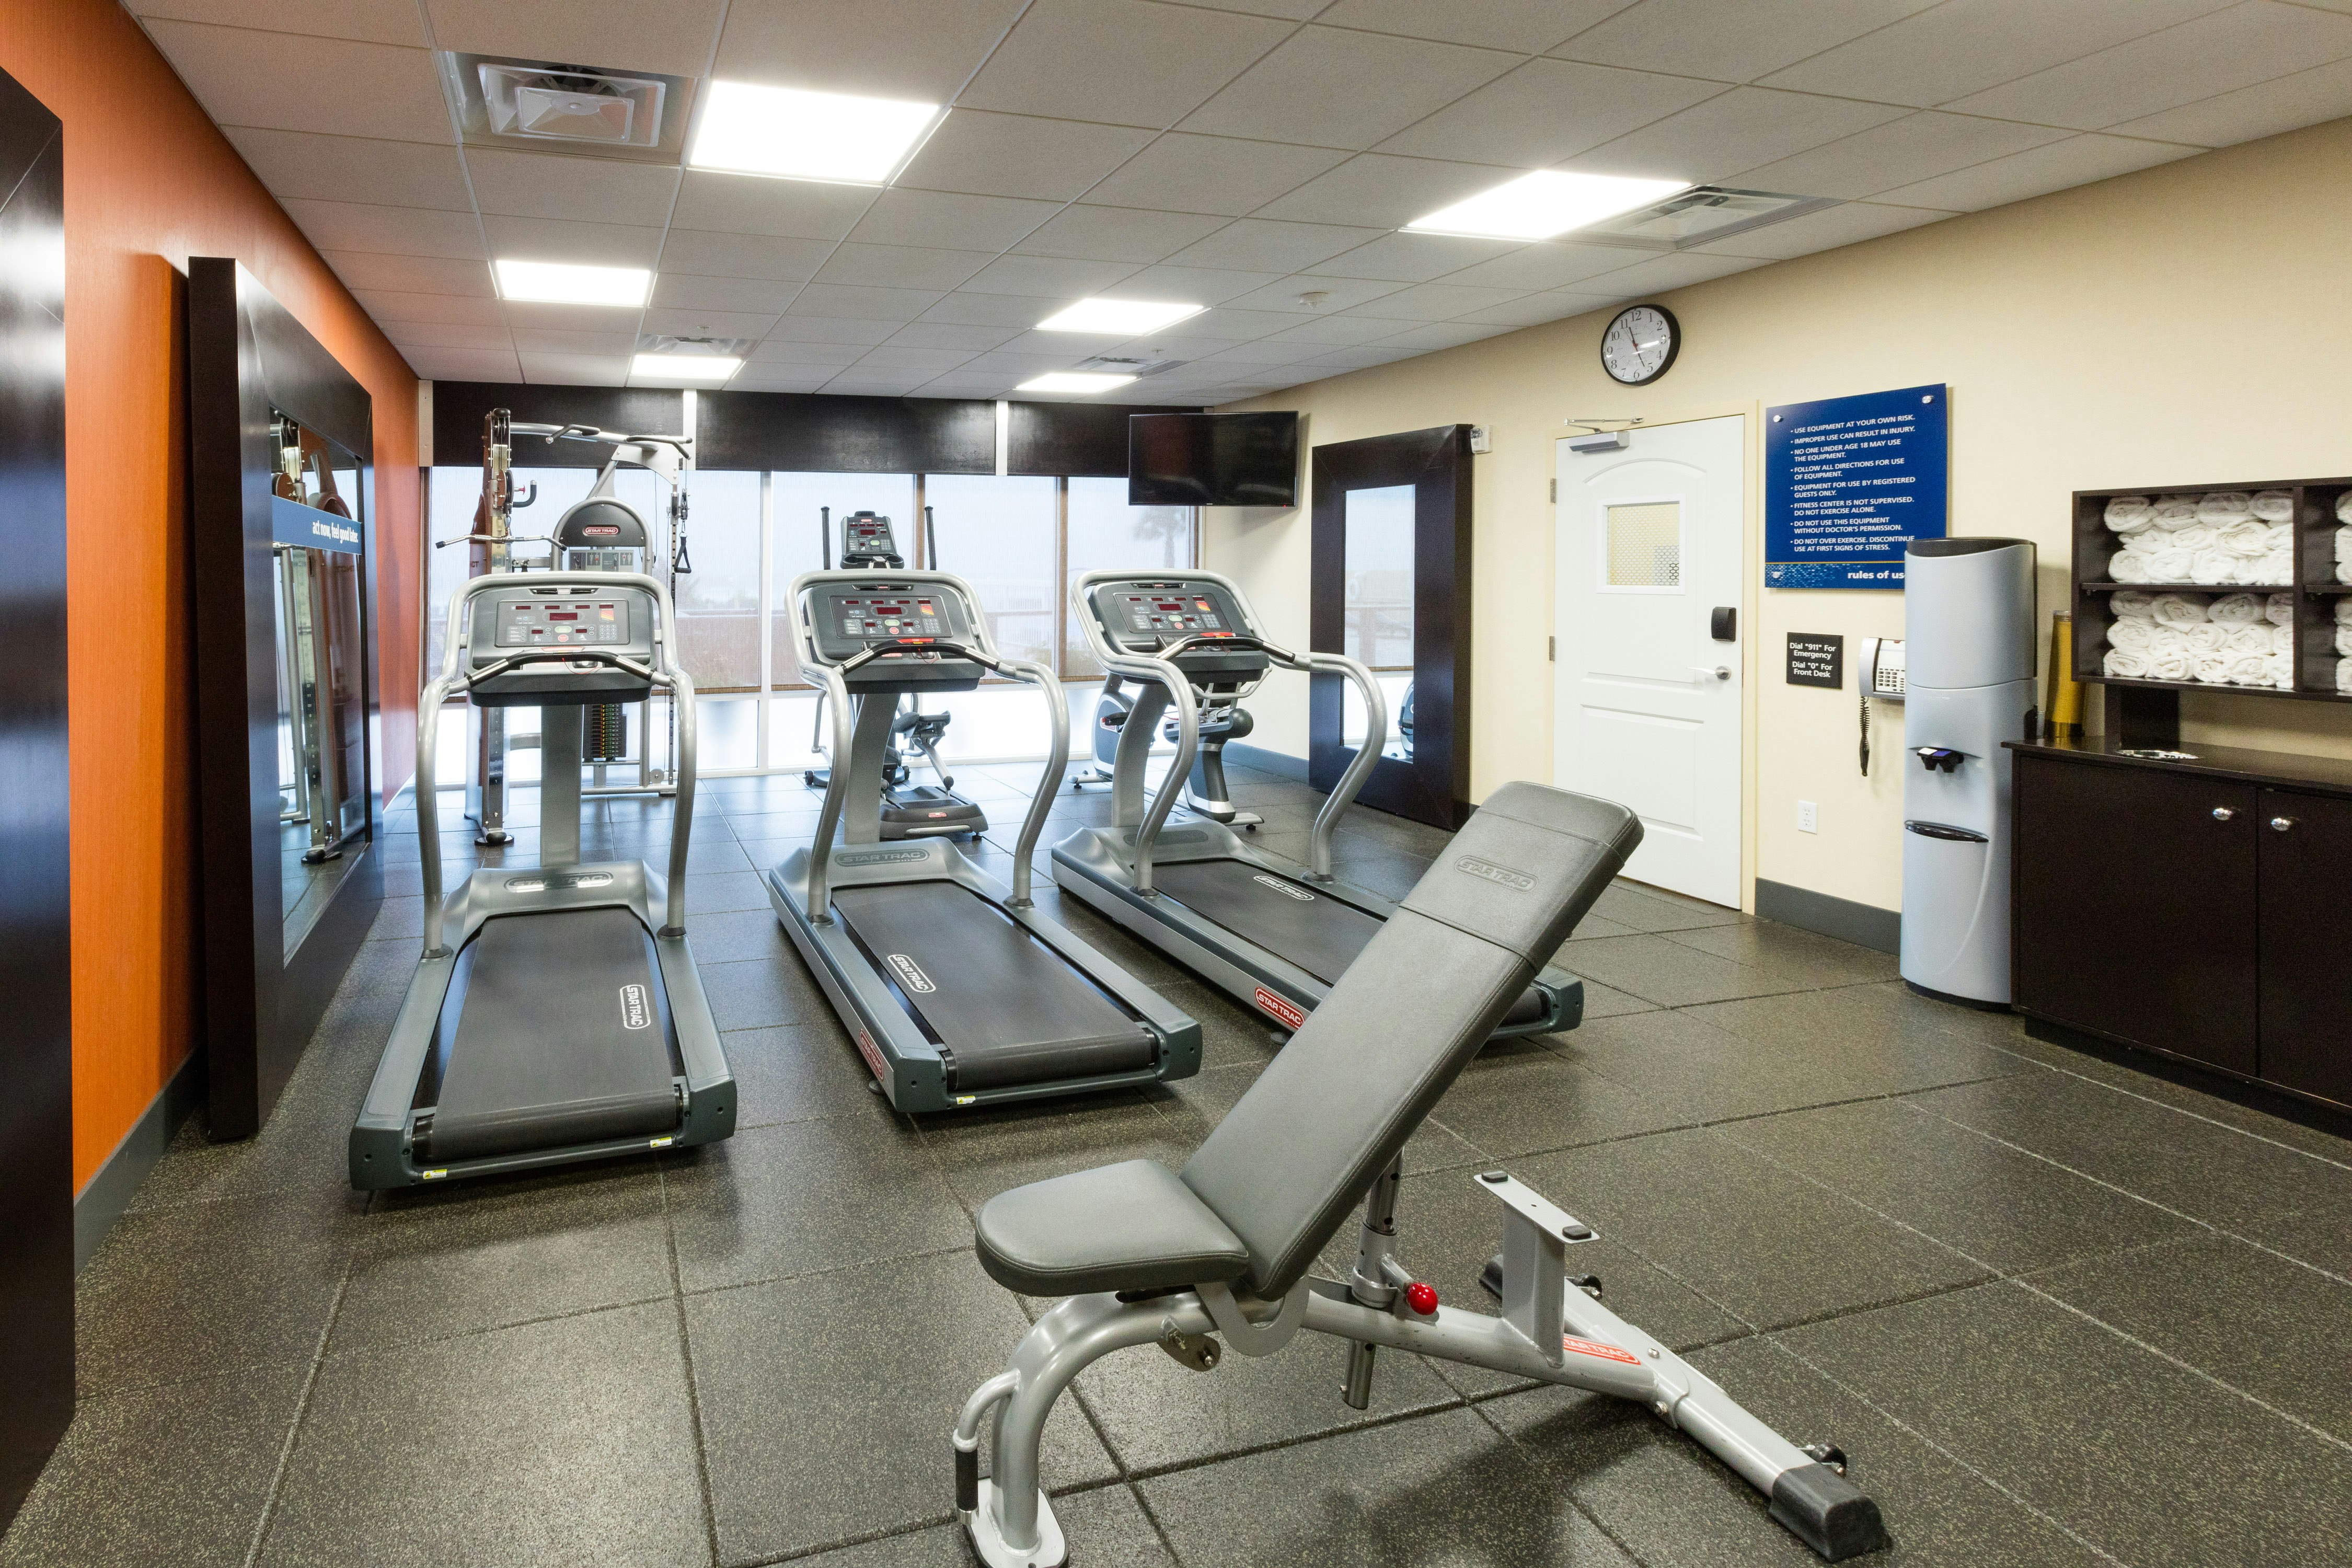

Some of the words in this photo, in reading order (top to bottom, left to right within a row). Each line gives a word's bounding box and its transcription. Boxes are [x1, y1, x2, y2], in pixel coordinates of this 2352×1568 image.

[1631, 310, 1641, 322] 12
[1648, 312, 1653, 322] 1
[1620, 319, 1629, 329] 11
[1657, 320, 1663, 331] 2
[1610, 330, 1620, 342] 10
[1661, 334, 1667, 344] 3
[1607, 346, 1613, 356] 9
[1656, 350, 1663, 360] 4
[1611, 360, 1617, 370] 8
[1647, 362, 1653, 373] 5
[1621, 368, 1627, 377] 7
[1633, 369, 1640, 379] 6
[1807, 422, 1845, 432] EQUIPMENT
[1794, 435, 1825, 444] IMPROPER
[1807, 452, 1847, 461] EQUIPMENT.
[1835, 460, 1874, 469] DIRECTIONS
[1804, 470, 1843, 479] EQUIPMENT.
[1794, 482, 1832, 491] EQUIPMENT
[1873, 477, 1916, 485] REGISTERED
[320, 524, 331, 539] now,
[340, 526, 350, 544] good
[349, 527, 359, 543] later.
[1848, 571, 1875, 579] rules
[1876, 570, 1889, 579] of
[1794, 650, 1831, 660] Emergency
[1457, 860, 1493, 875] STAR
[1494, 870, 1531, 888] TRAC
[1258, 876, 1284, 887] STAR
[1281, 886, 1308, 898] TRAC
[892, 955, 914, 972] STAR
[907, 972, 929, 989] TRAC
[627, 985, 640, 1005] STAR
[1257, 994, 1278, 1011] STAR
[1278, 1006, 1301, 1025] TRAC
[629, 1005, 643, 1025] TRAC
[860, 1036, 871, 1055] STAR
[870, 1052, 882, 1073] TRAC
[1564, 1340, 1591, 1350] TAR
[1590, 1345, 1629, 1358] TRAC
